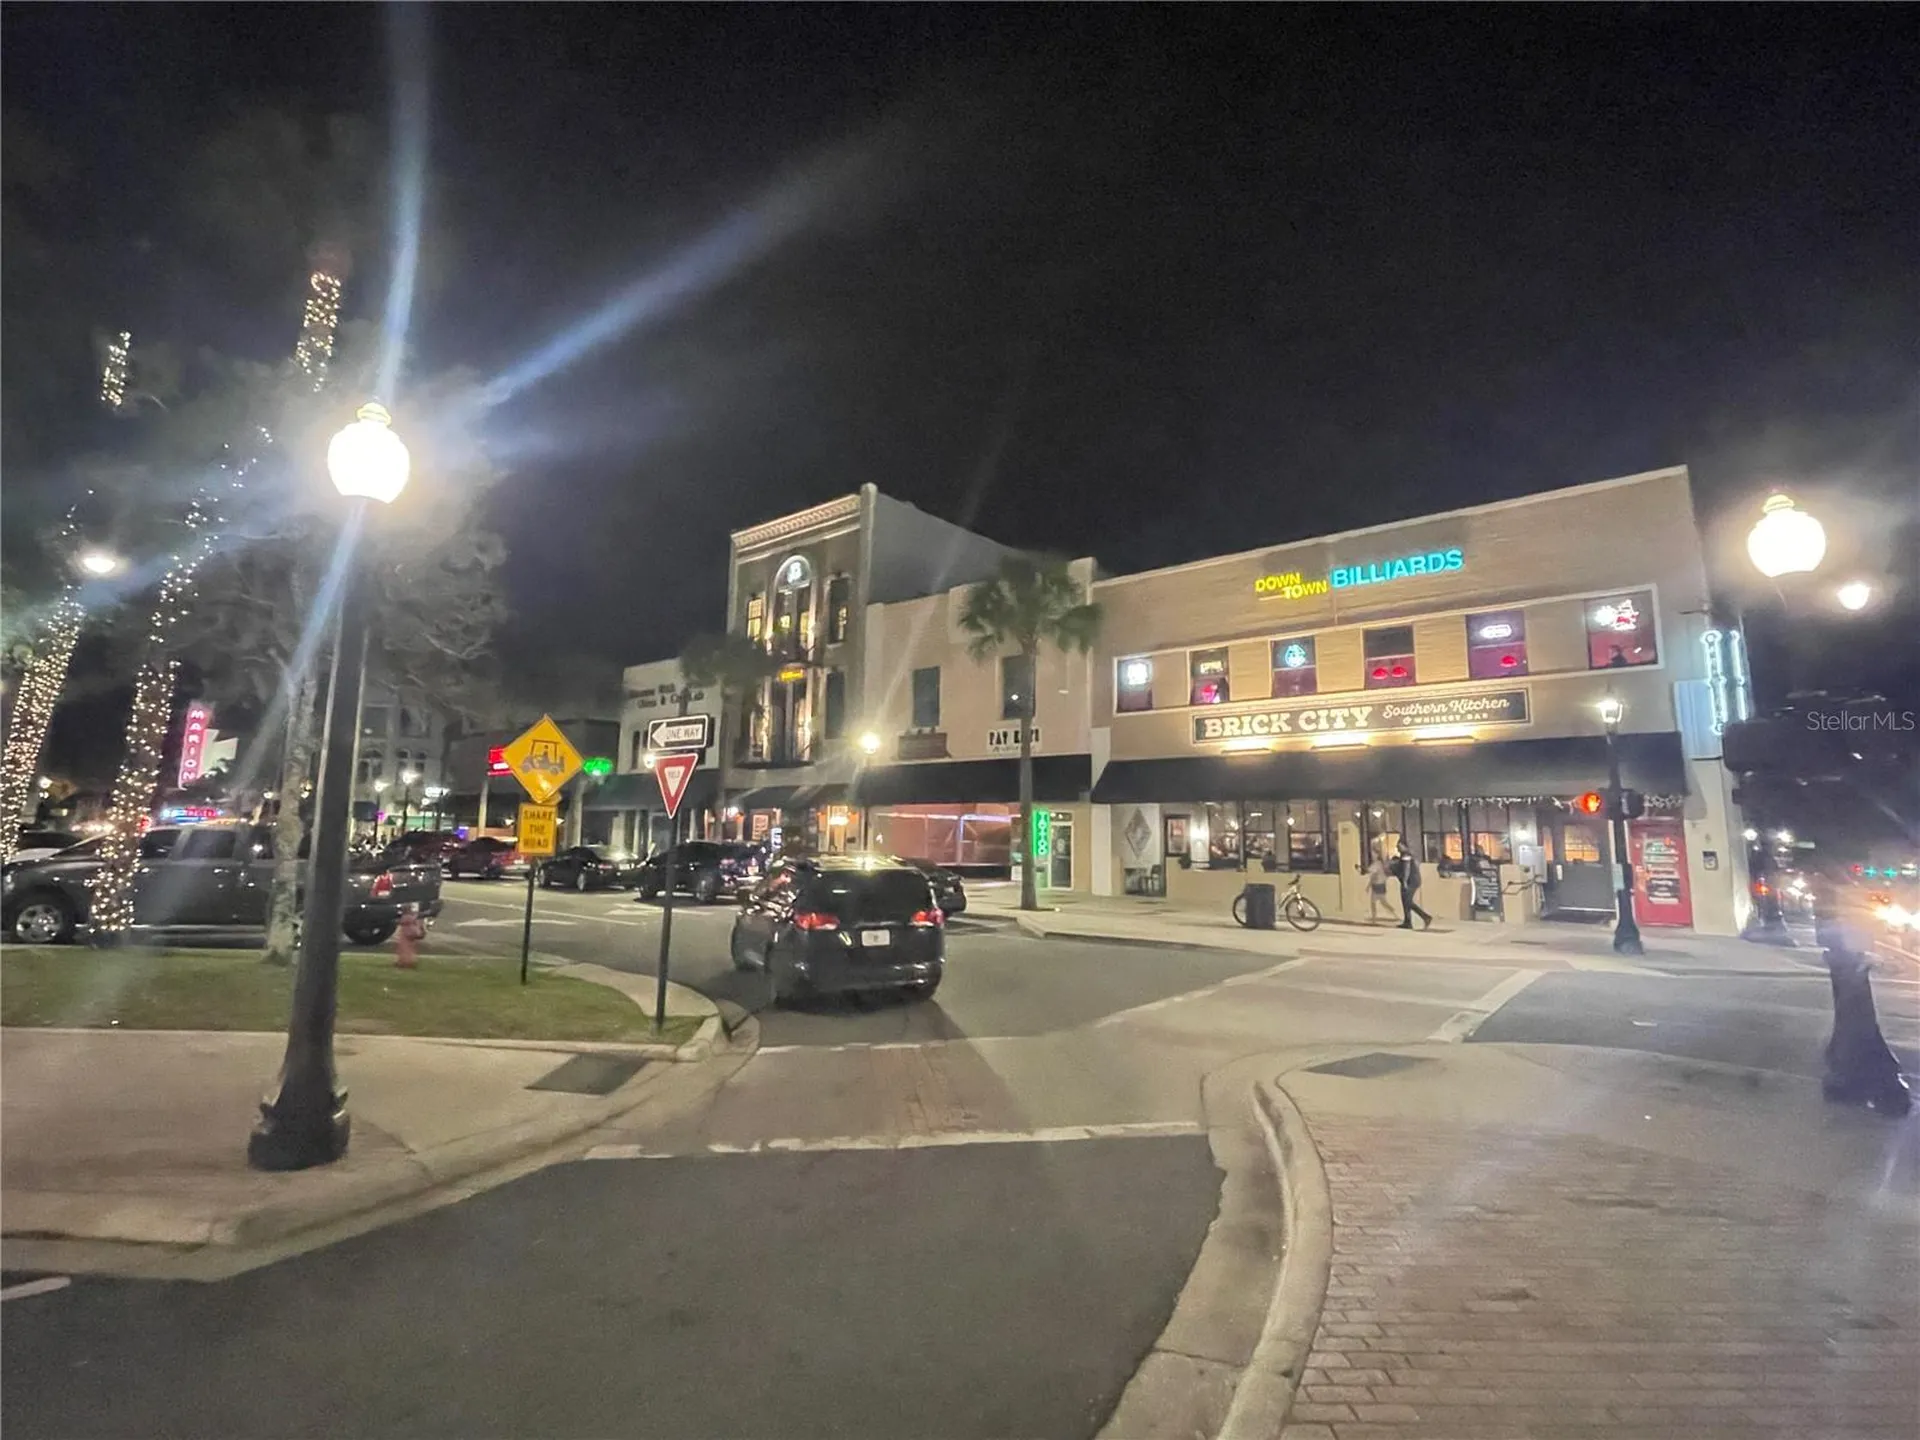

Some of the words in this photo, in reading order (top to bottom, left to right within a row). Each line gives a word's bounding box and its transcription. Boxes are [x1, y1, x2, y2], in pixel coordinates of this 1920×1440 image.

[1282, 580, 1328, 600] TOWN
[1331, 549, 1464, 589] BILLIARDS
[1255, 573, 1301, 592] DOWN
[1382, 703, 1448, 719] Southern
[1449, 697, 1510, 714] Kitchen
[1204, 712, 1292, 738] BRICK
[1298, 705, 1373, 731] CITY
[1413, 713, 1462, 723] WHISKEY
[1467, 712, 1489, 720] BAR
[684, 728, 700, 738] WAY
[182, 710, 205, 780] MARION
[523, 809, 553, 821] SHARE
[529, 824, 546, 835] THE
[523, 838, 550, 848] ROAD
